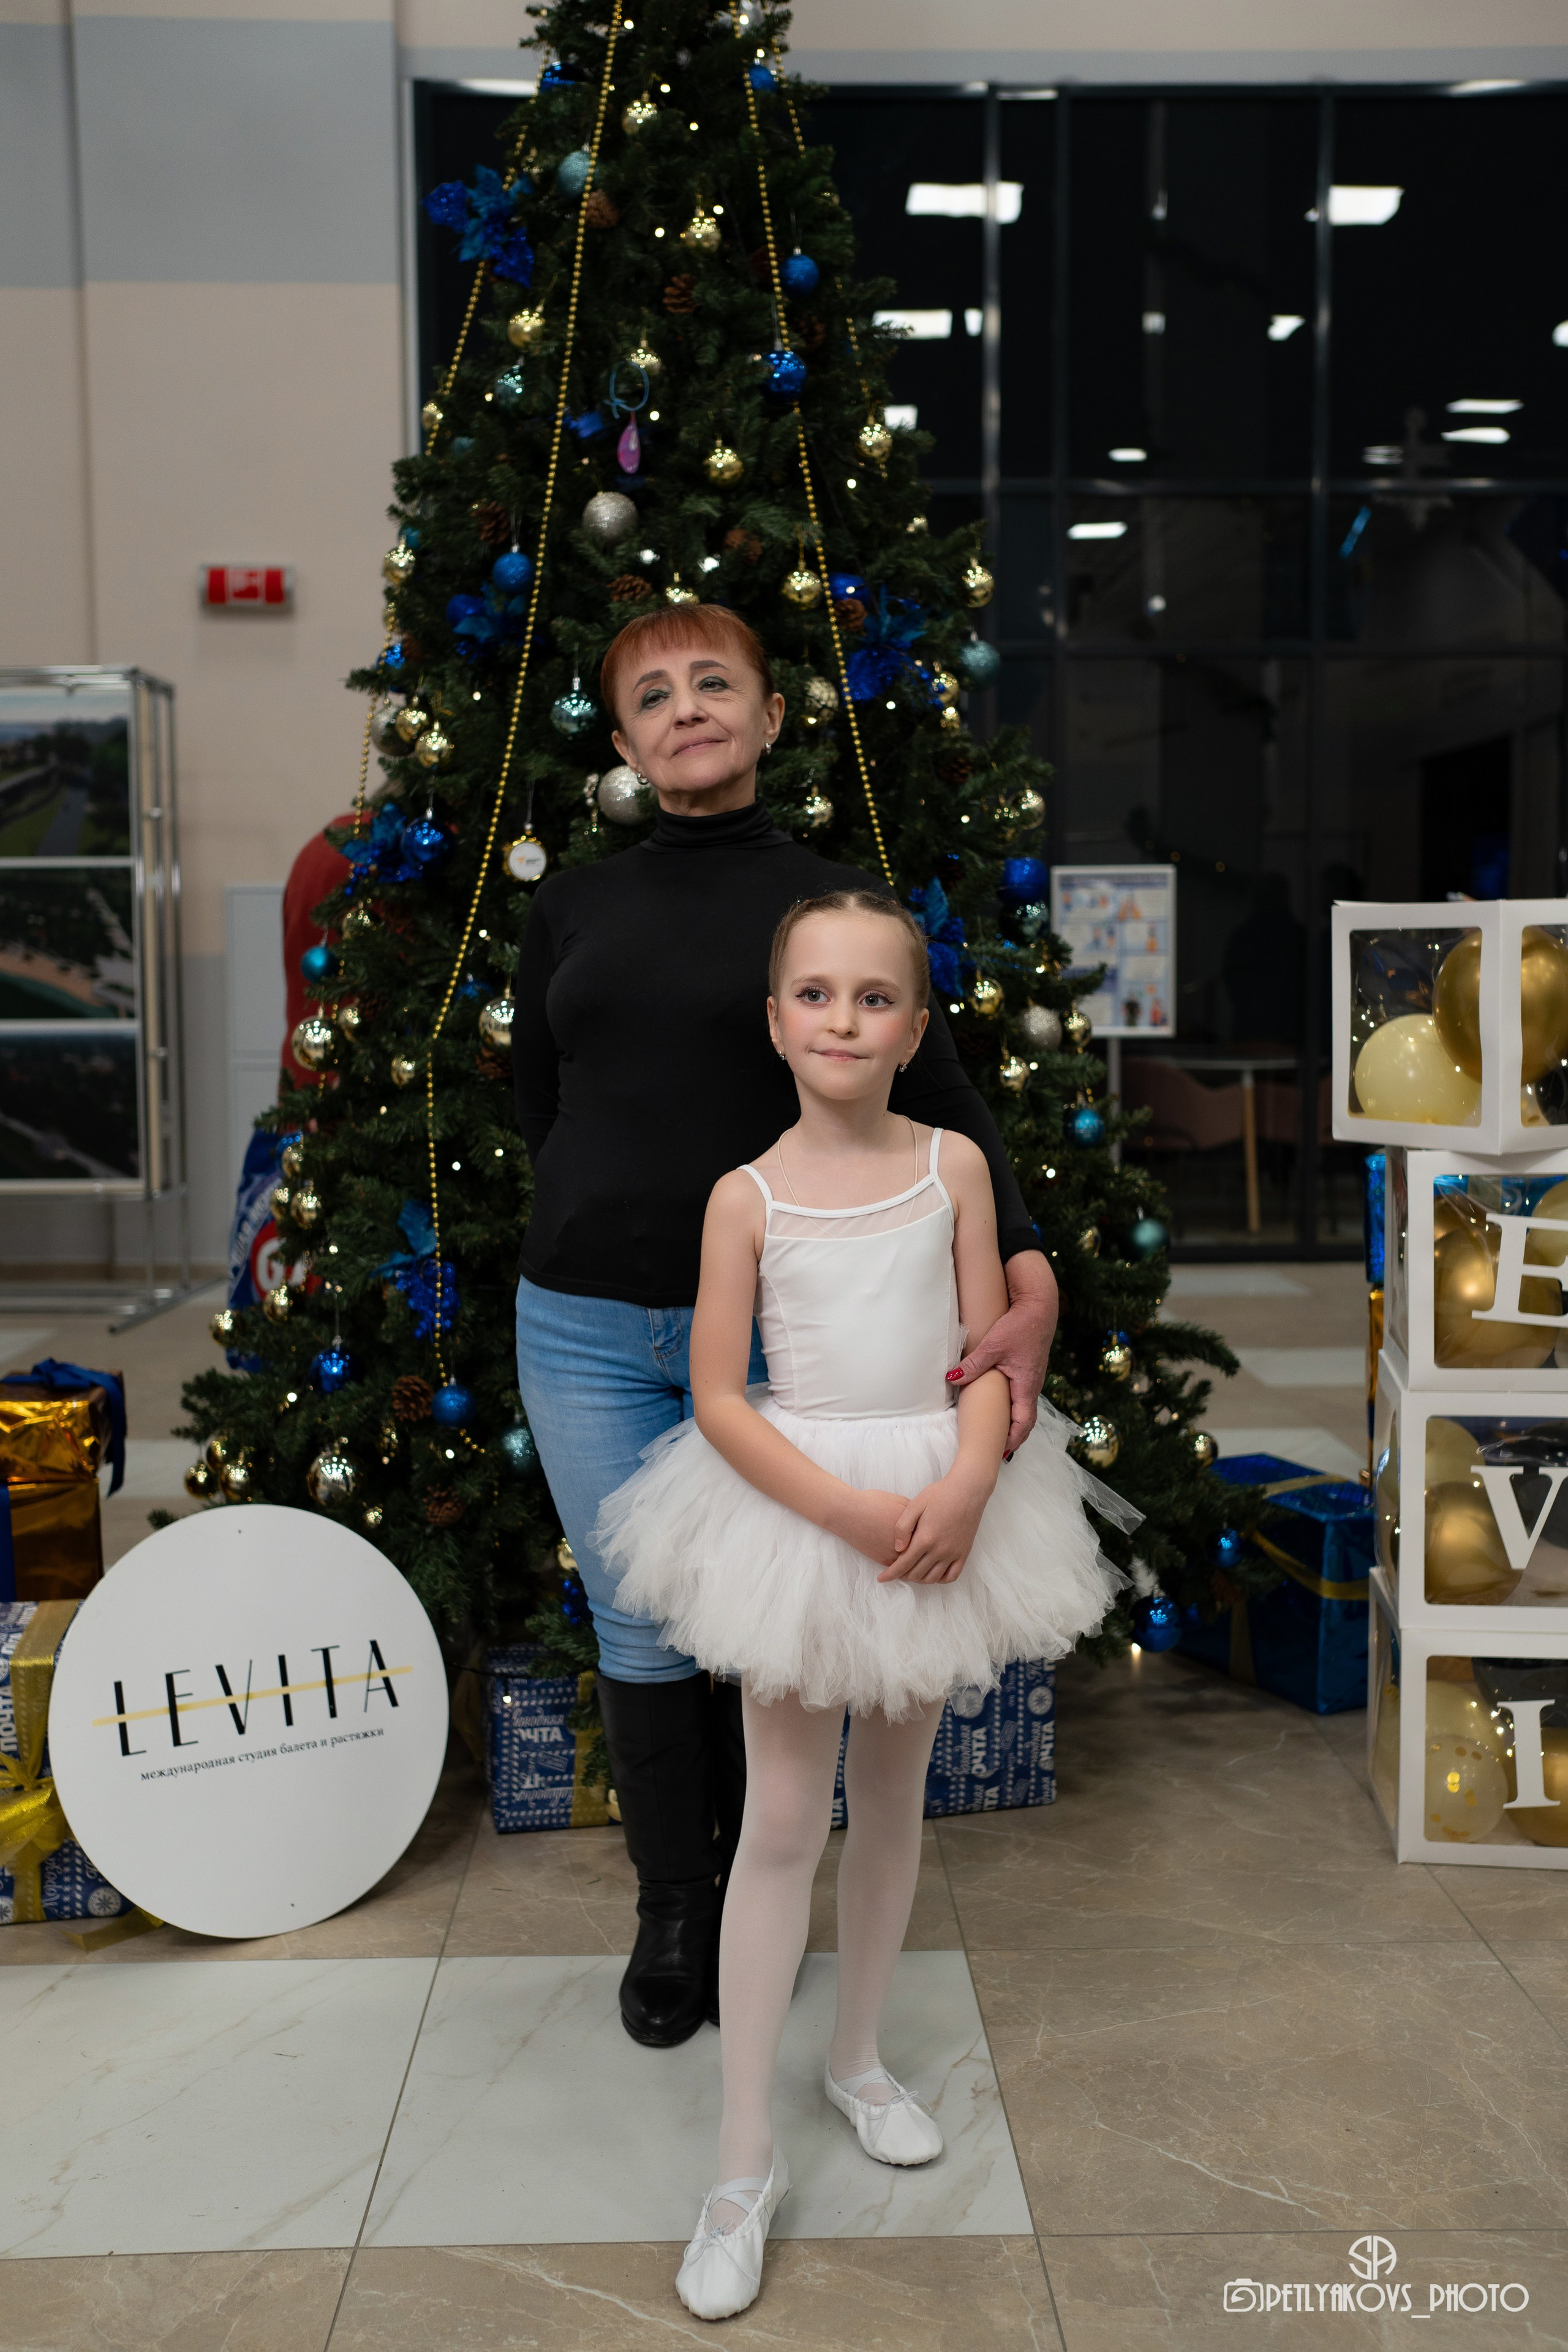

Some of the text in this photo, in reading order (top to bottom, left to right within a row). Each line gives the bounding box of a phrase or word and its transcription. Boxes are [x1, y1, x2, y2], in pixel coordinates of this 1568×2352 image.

[113, 1640, 399, 1756] LEVITA
[141, 1728, 385, 1781] международная студия балета и растяжки
